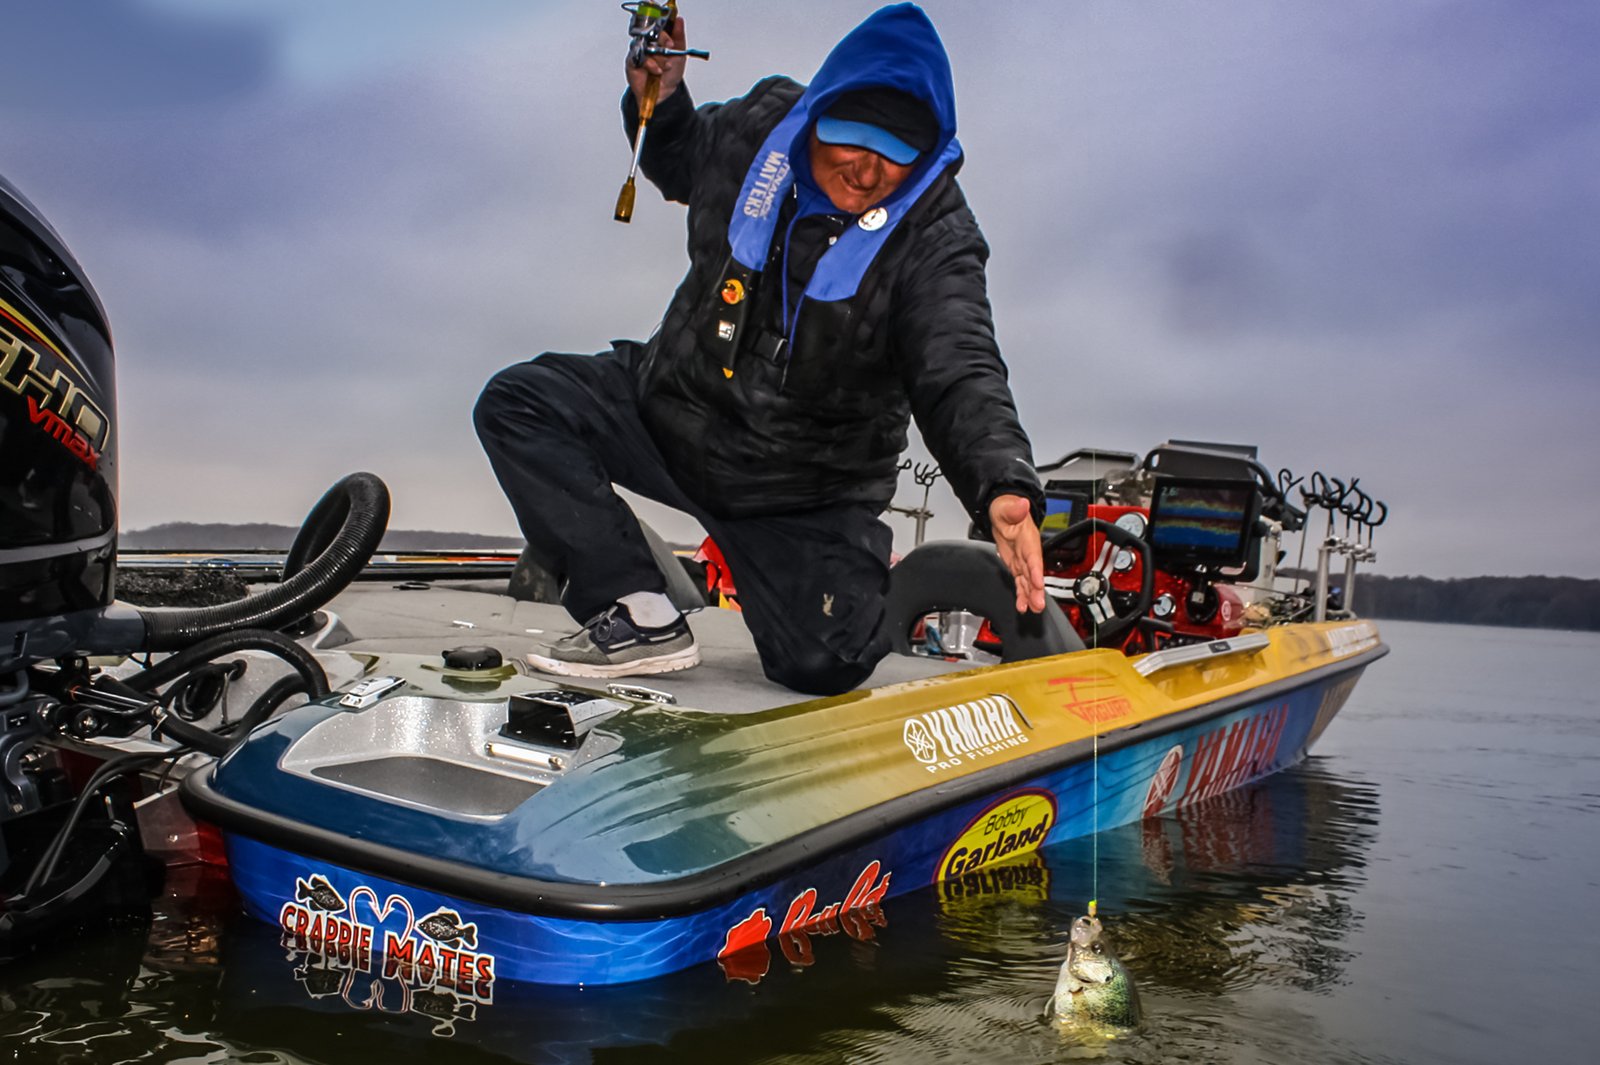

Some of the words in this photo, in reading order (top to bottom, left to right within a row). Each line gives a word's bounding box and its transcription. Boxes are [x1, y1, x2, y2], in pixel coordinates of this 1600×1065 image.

[743, 150, 786, 218] MATTERS
[921, 694, 1023, 758] YAMAHA
[925, 757, 962, 774] PRO
[967, 733, 1030, 761] FISHING
[944, 813, 1049, 880] Garland
[983, 805, 1029, 836] Bobby
[279, 902, 374, 950] CRAPPIE
[387, 931, 495, 982] MATES
